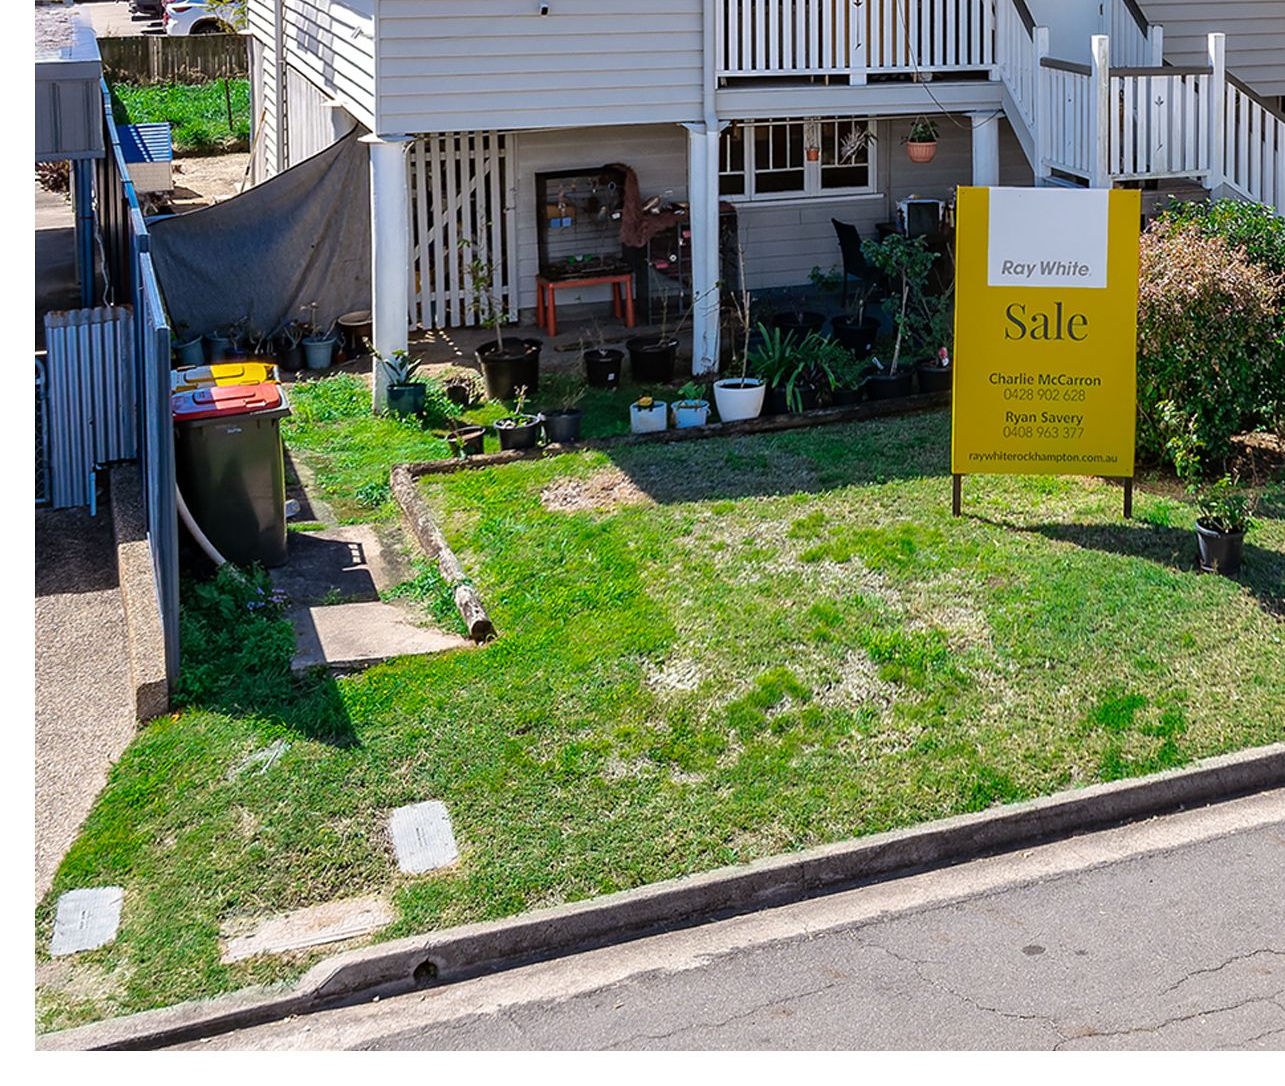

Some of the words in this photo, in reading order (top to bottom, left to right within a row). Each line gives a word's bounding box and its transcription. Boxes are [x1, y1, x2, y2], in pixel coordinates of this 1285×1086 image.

[1001, 259, 1037, 278] Ray
[1004, 300, 1089, 342] Sale
[988, 372, 1035, 386] Charlie
[1037, 373, 1102, 387] McCarron
[1003, 387, 1034, 401] 0428
[1037, 388, 1059, 401] 902
[1062, 389, 1086, 402] 628
[1005, 410, 1037, 425] Ryan
[1041, 411, 1084, 426] Savery
[1002, 425, 1033, 439] 0408
[1036, 426, 1059, 439] 963
[1062, 427, 1085, 439] 377
[968, 450, 1118, 464] raywhiterockhampton.com.au
